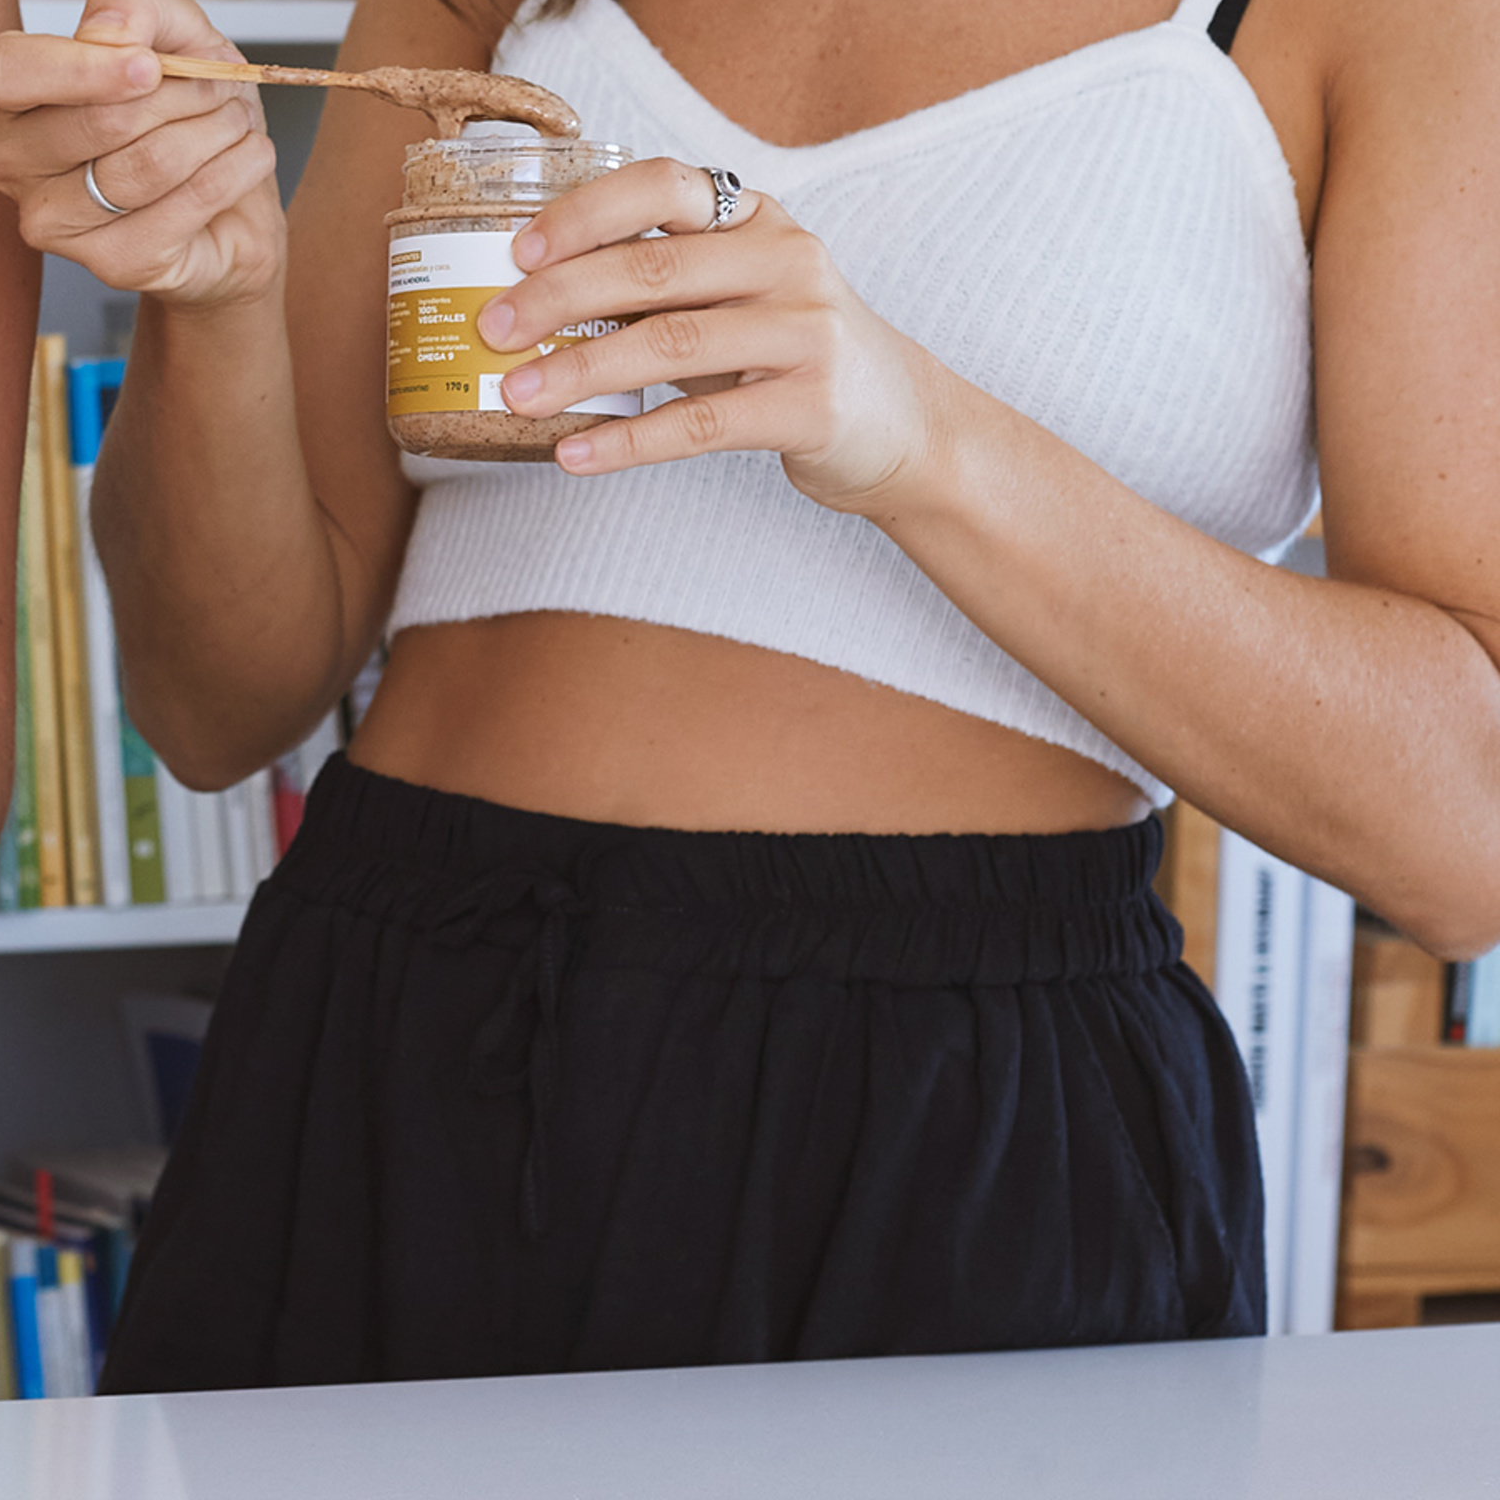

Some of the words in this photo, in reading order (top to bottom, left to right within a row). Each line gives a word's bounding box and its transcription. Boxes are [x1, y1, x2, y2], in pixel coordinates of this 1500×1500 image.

[418, 306, 438, 315] 100%
[418, 313, 466, 324] VEGETALES
[417, 352, 446, 363] OMEGA
[448, 351, 455, 361] 9
[445, 381, 462, 391] 170
[463, 383, 470, 393] g
